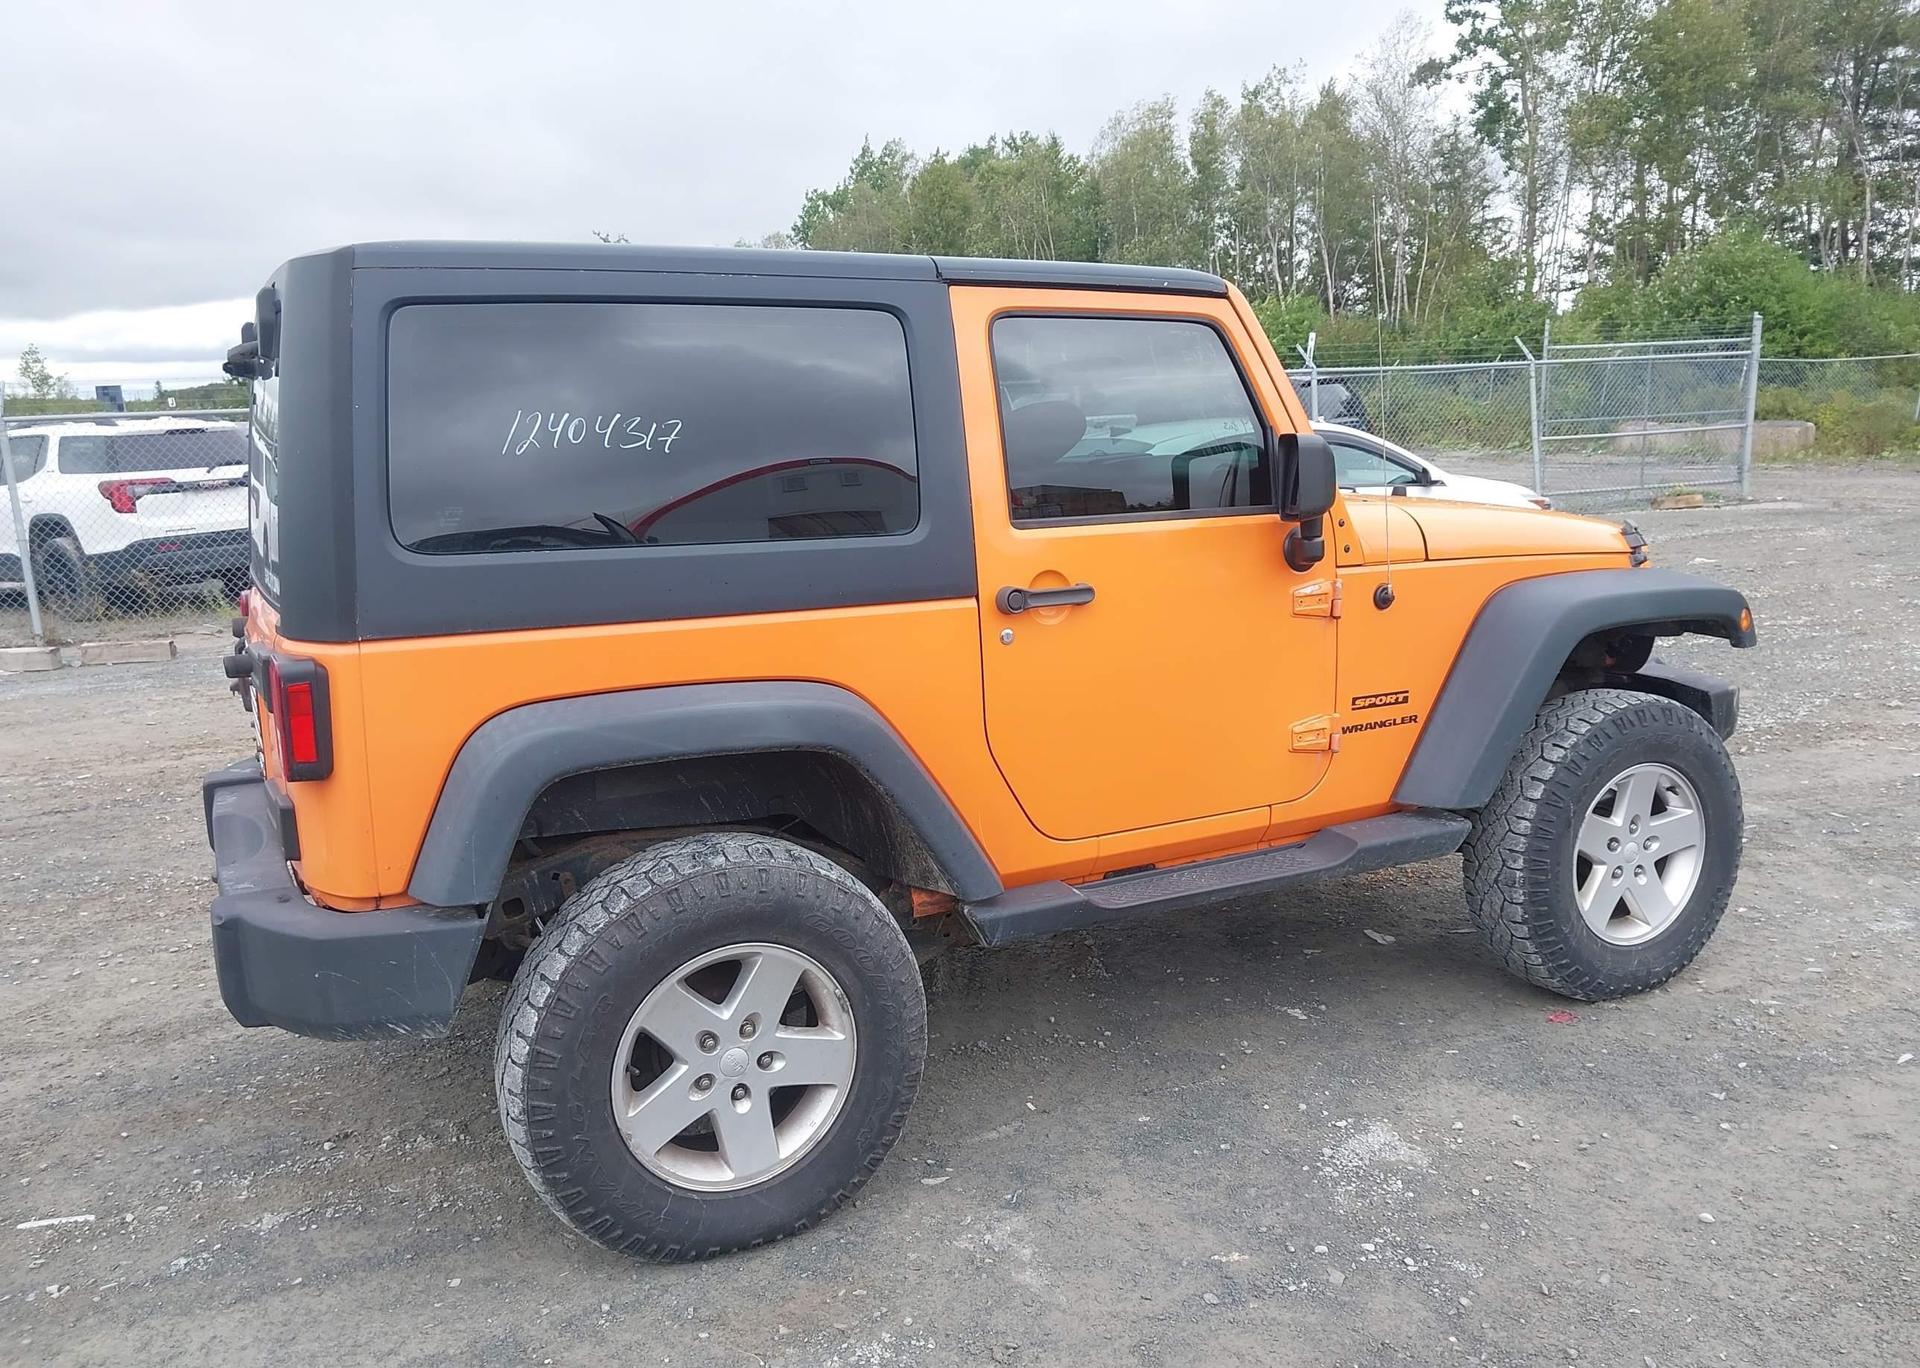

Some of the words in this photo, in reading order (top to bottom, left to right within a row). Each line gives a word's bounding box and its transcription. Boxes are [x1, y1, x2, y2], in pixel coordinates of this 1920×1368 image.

[502, 409, 682, 455] 12404317
[1354, 693, 1407, 708] SPORT
[1341, 714, 1418, 735] WRANGLER
